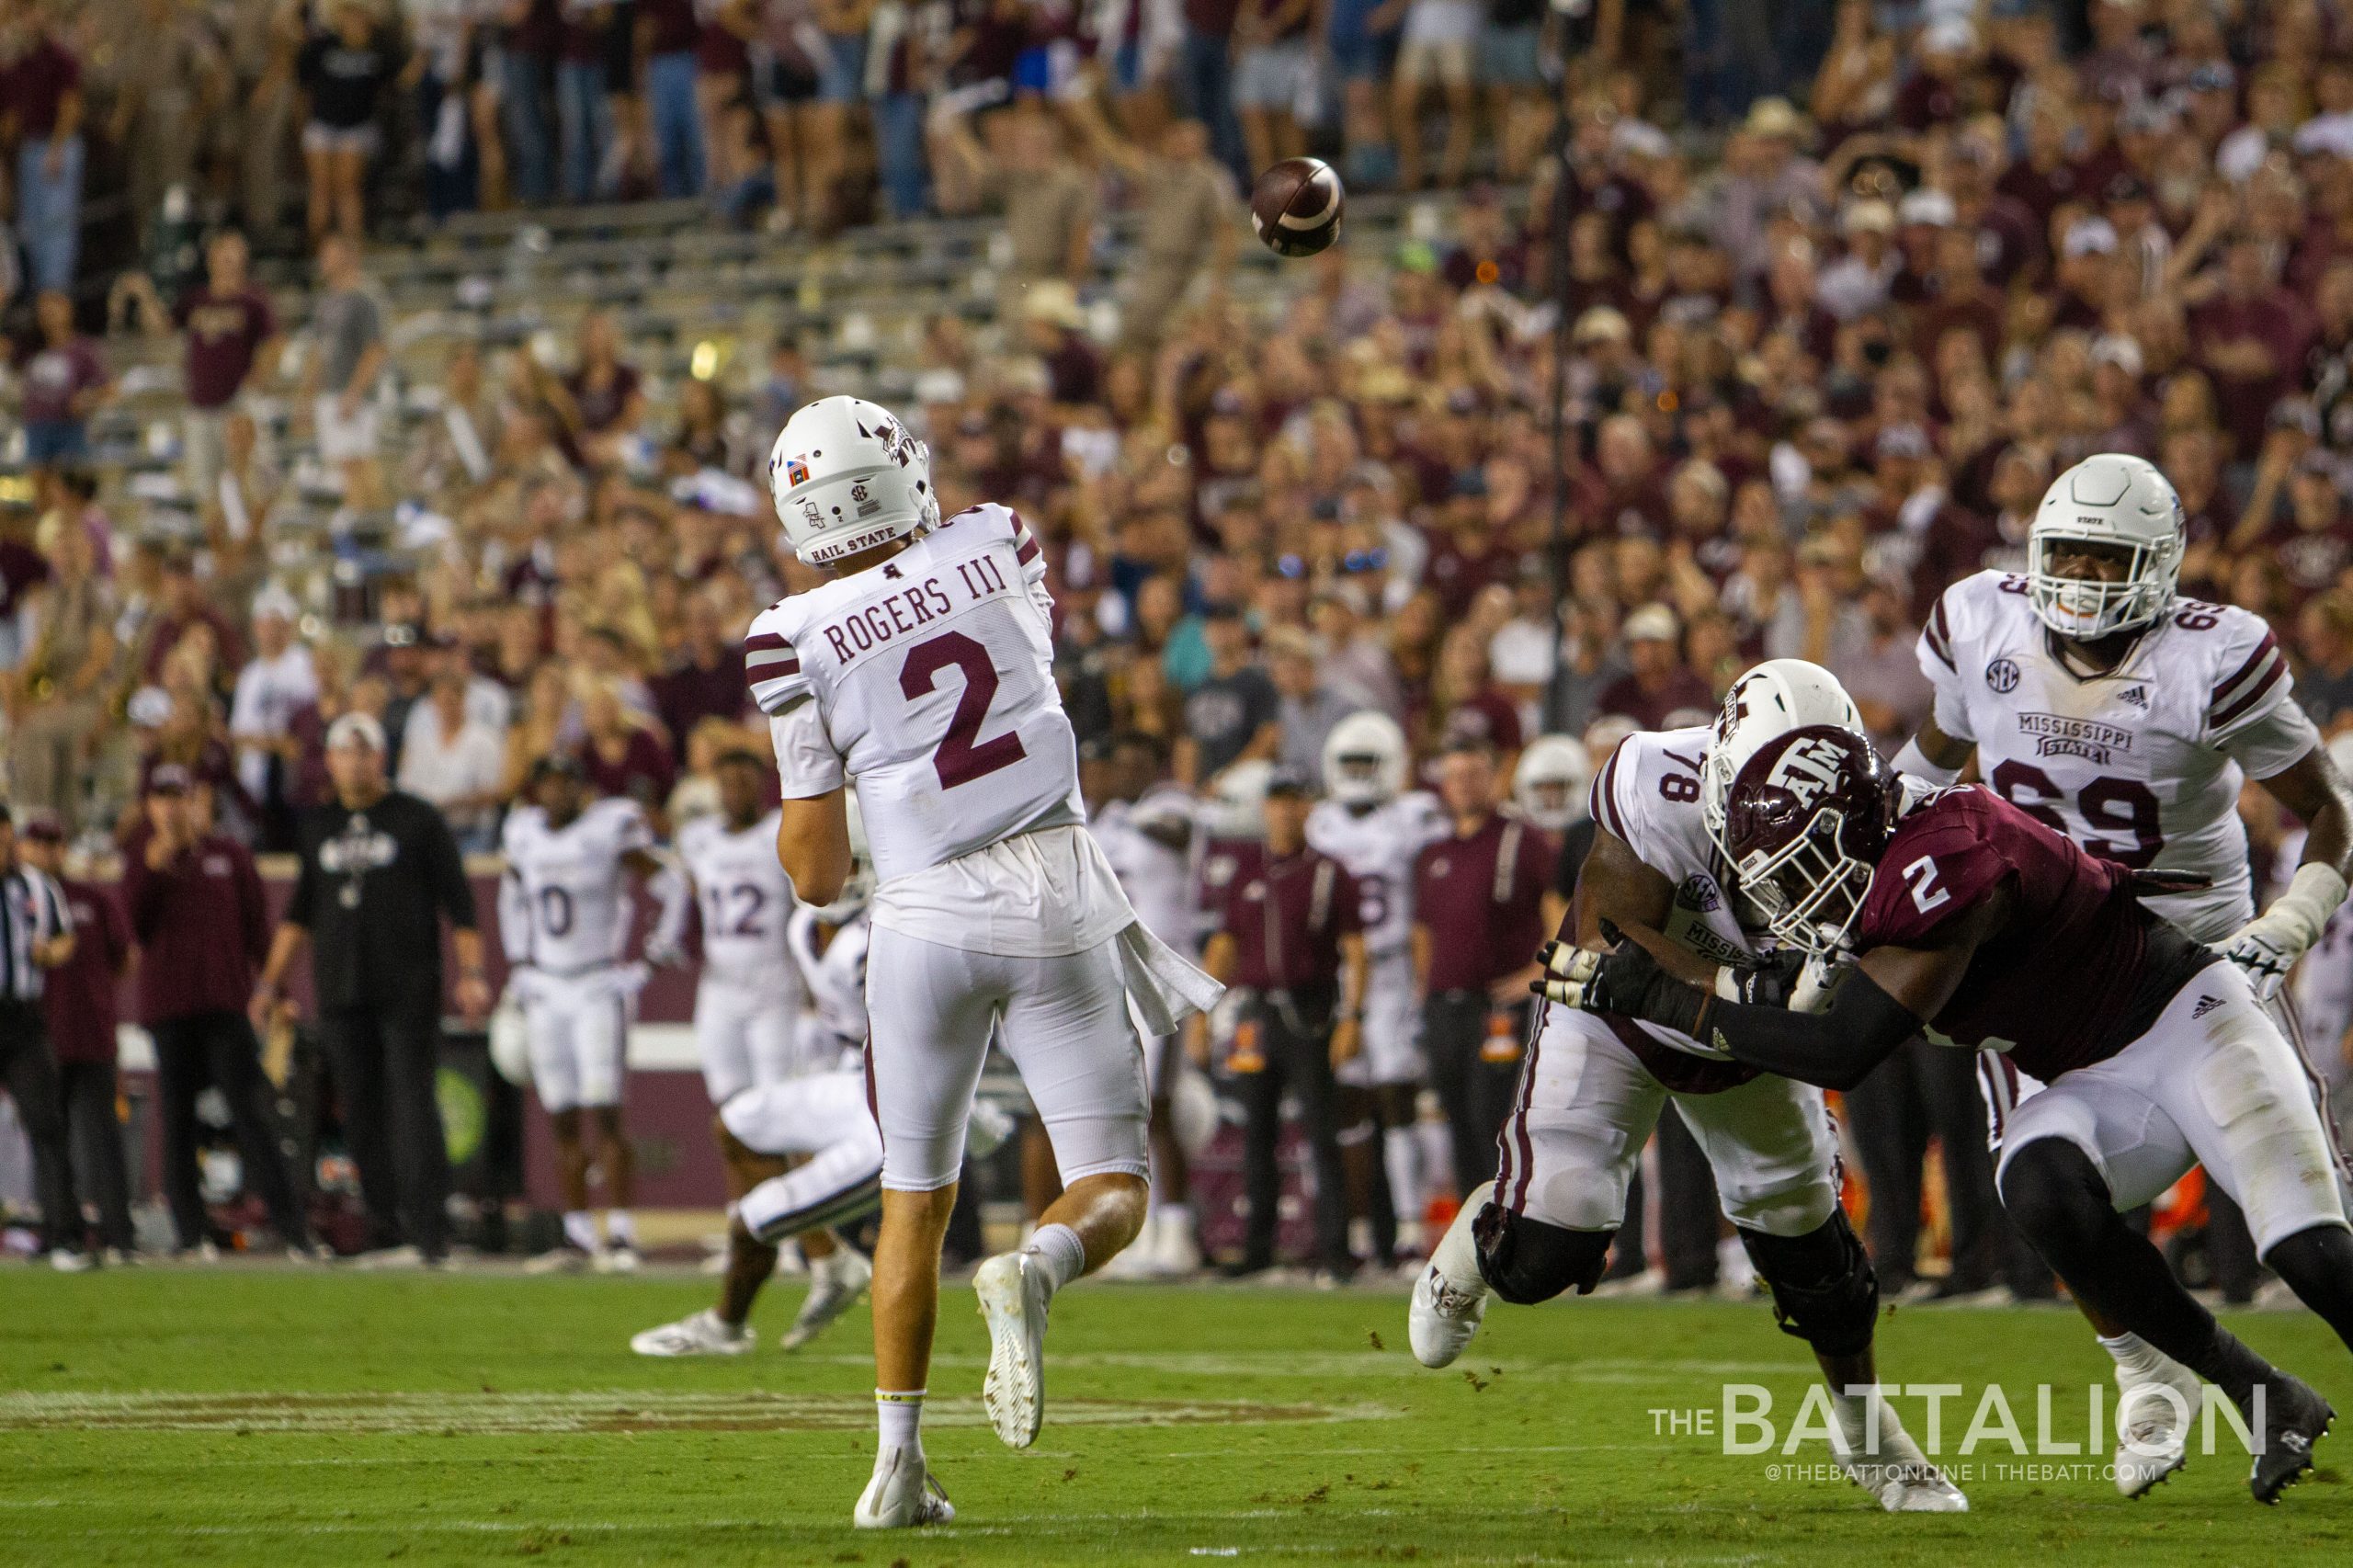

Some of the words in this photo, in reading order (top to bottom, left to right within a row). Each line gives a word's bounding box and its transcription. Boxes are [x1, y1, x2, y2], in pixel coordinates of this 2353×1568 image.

[851, 485, 869, 502] SEC
[811, 544, 845, 562] HAIL
[847, 527, 897, 551] STATE
[824, 577, 952, 665] ROGERS
[956, 554, 1006, 600] III
[1986, 659, 2019, 694] SEC
[899, 631, 1028, 790] 2
[2018, 714, 2133, 750] MISSISSIPPI
[2045, 737, 2106, 766] STATE
[1658, 748, 1708, 803] 78
[1992, 757, 2165, 869] 69
[1902, 855, 1951, 915] 2
[1687, 921, 1745, 960] MISSIS
